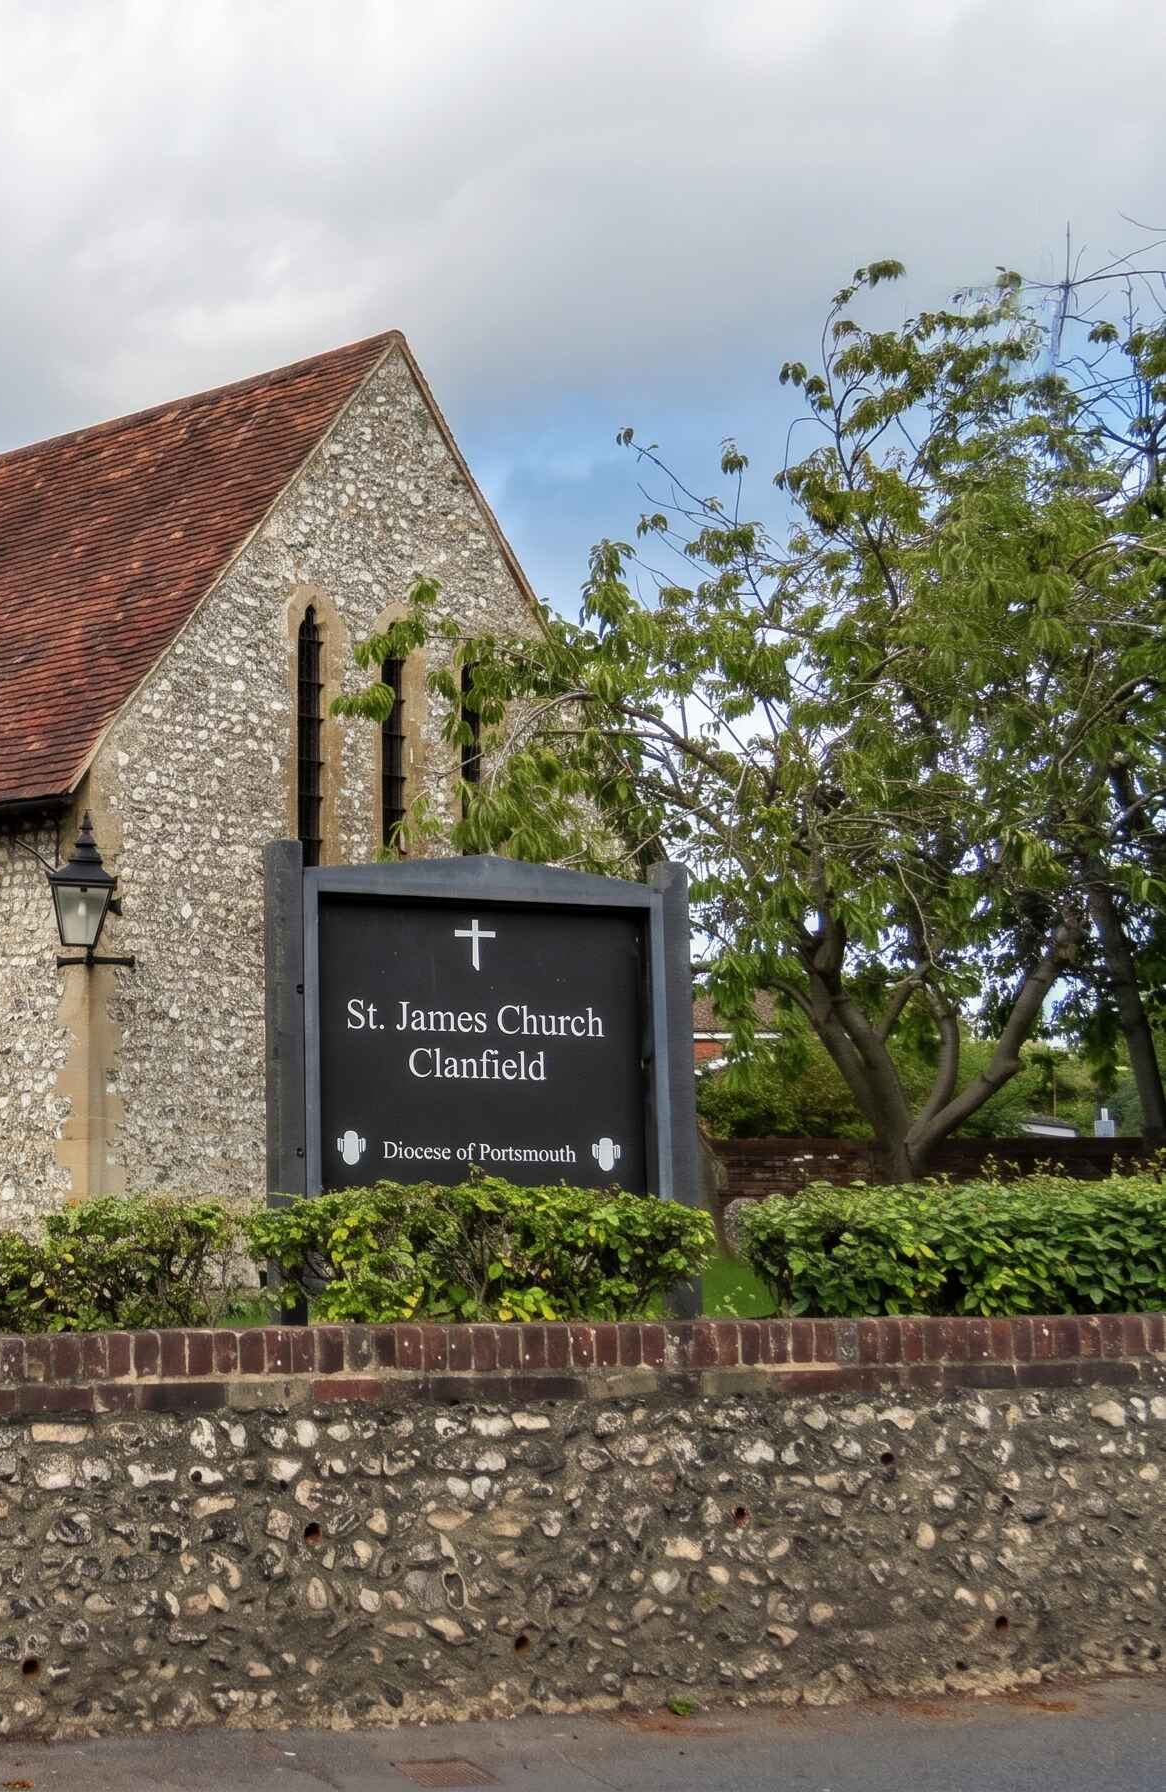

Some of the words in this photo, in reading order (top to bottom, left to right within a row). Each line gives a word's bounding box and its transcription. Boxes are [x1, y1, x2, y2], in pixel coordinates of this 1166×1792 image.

[346, 998, 385, 1030] St.
[396, 1001, 488, 1034] James
[496, 1004, 605, 1038] Church
[408, 1047, 547, 1081] Clanfield
[383, 1140, 452, 1161] Diocese
[456, 1142, 477, 1161] of
[478, 1143, 577, 1163] Portsmouth
